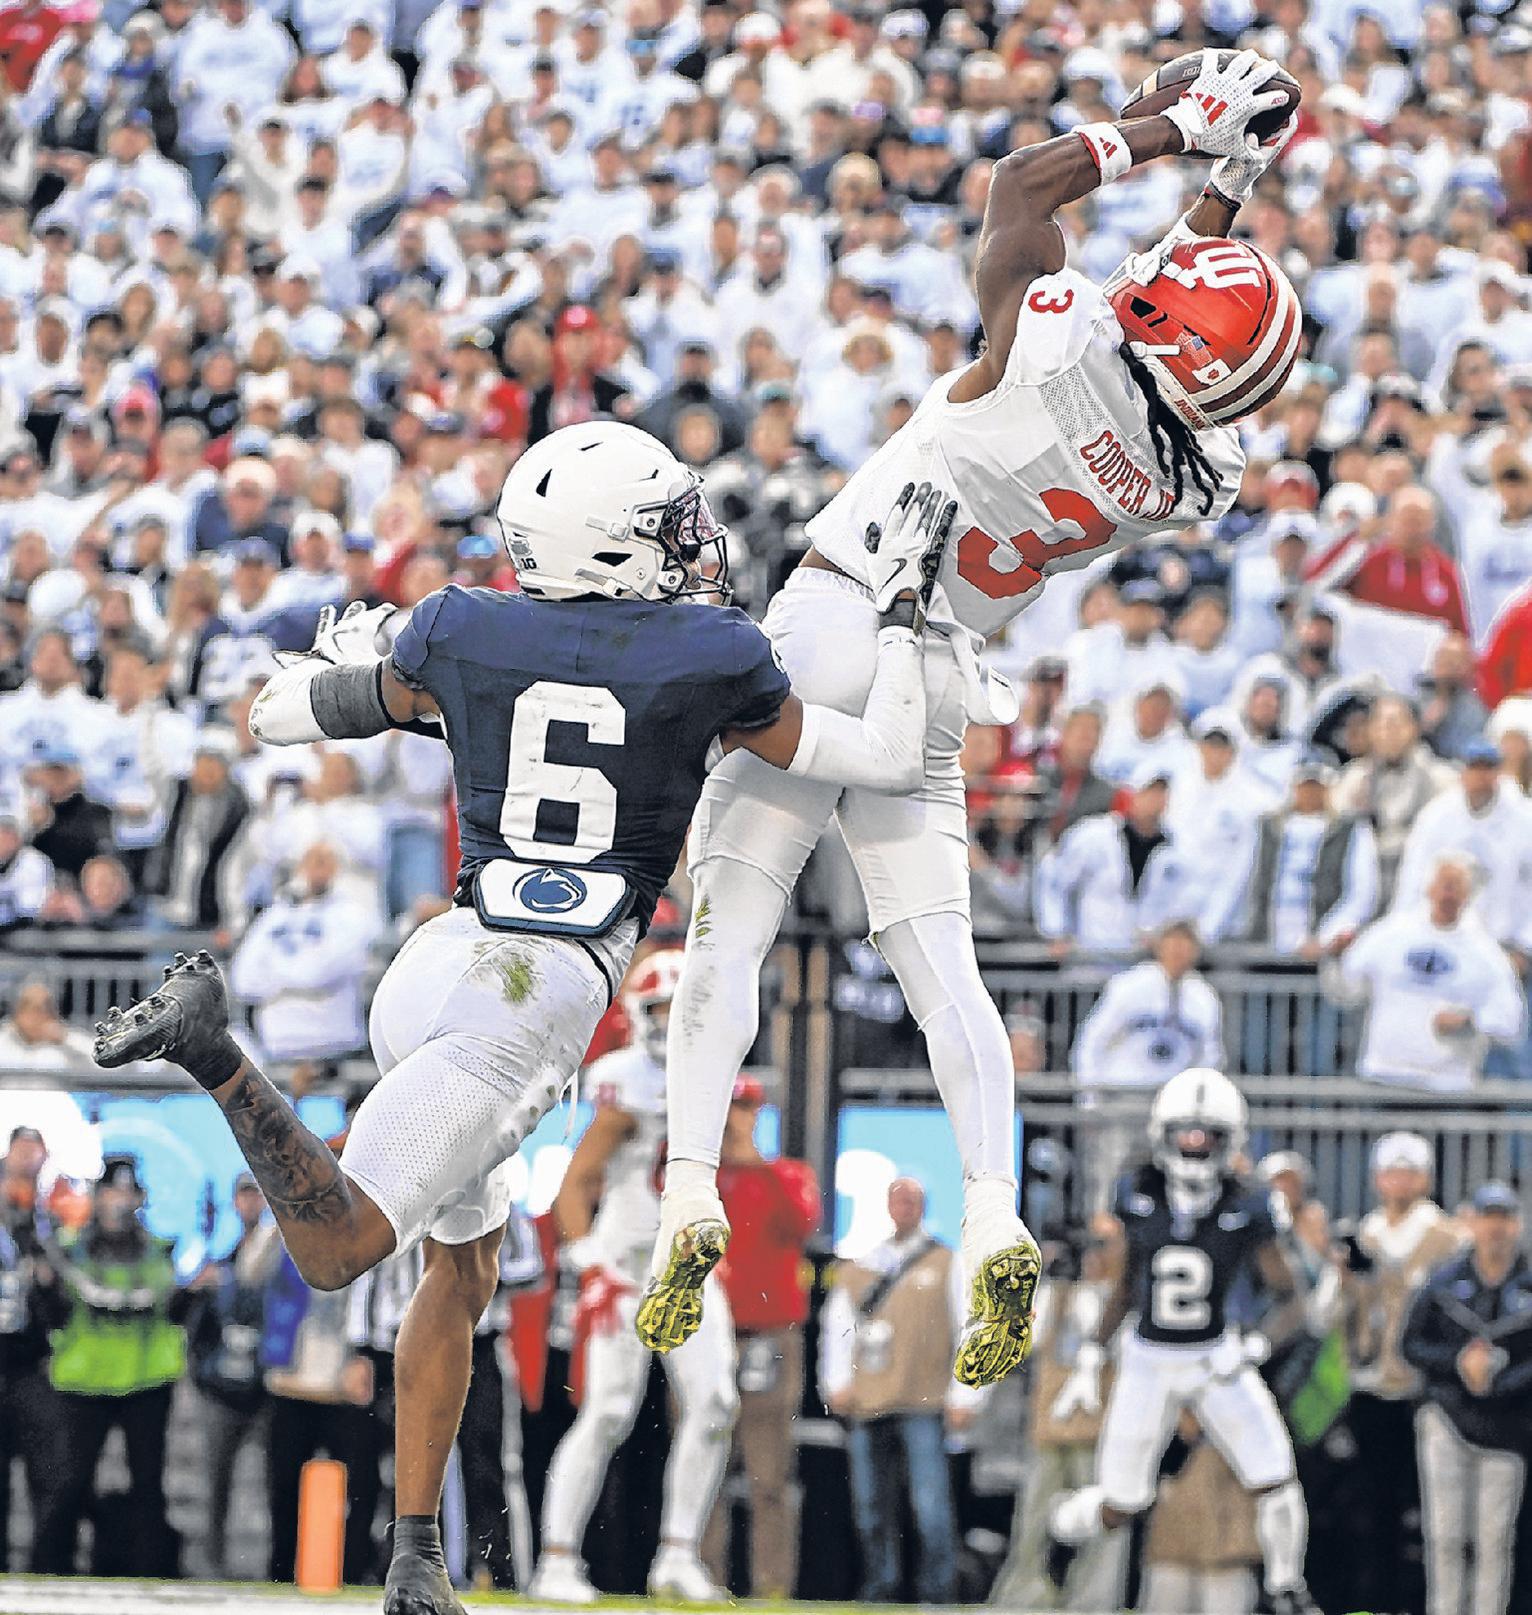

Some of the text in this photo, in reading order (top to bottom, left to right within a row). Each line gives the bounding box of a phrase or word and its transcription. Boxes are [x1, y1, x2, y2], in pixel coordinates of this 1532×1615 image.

[1028, 289, 1074, 314] 3
[1080, 430, 1152, 516] COOPER
[957, 487, 1118, 600] 3
[499, 680, 627, 865] 6
[1151, 1245, 1213, 1330] 2
